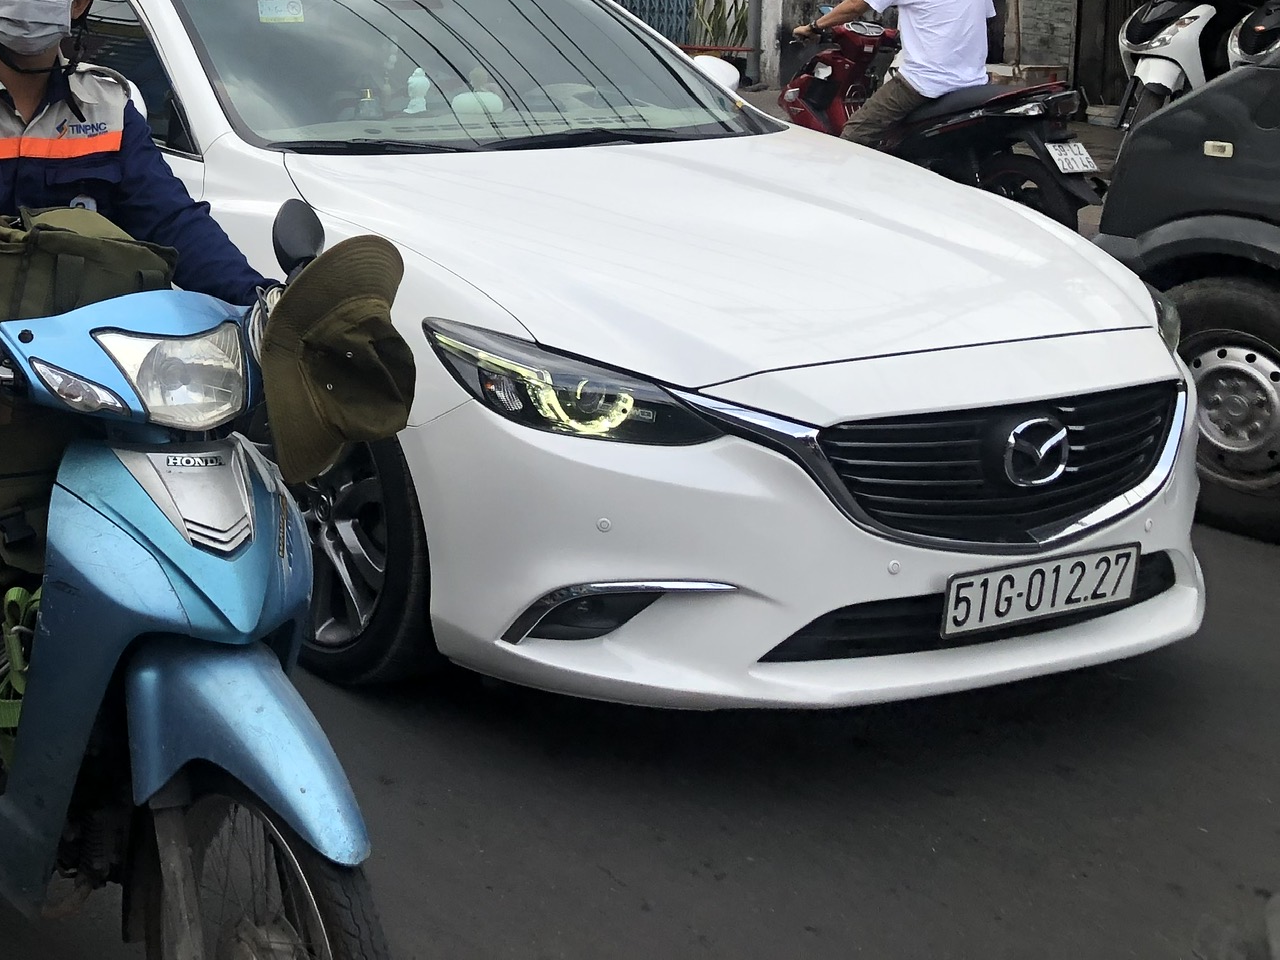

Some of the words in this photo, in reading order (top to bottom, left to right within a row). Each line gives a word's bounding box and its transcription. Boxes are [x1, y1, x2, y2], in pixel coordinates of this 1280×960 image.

[1052, 144, 1084, 156] 59-L2
[168, 456, 225, 466] HONDA
[952, 552, 1132, 628] 51G-012.27
